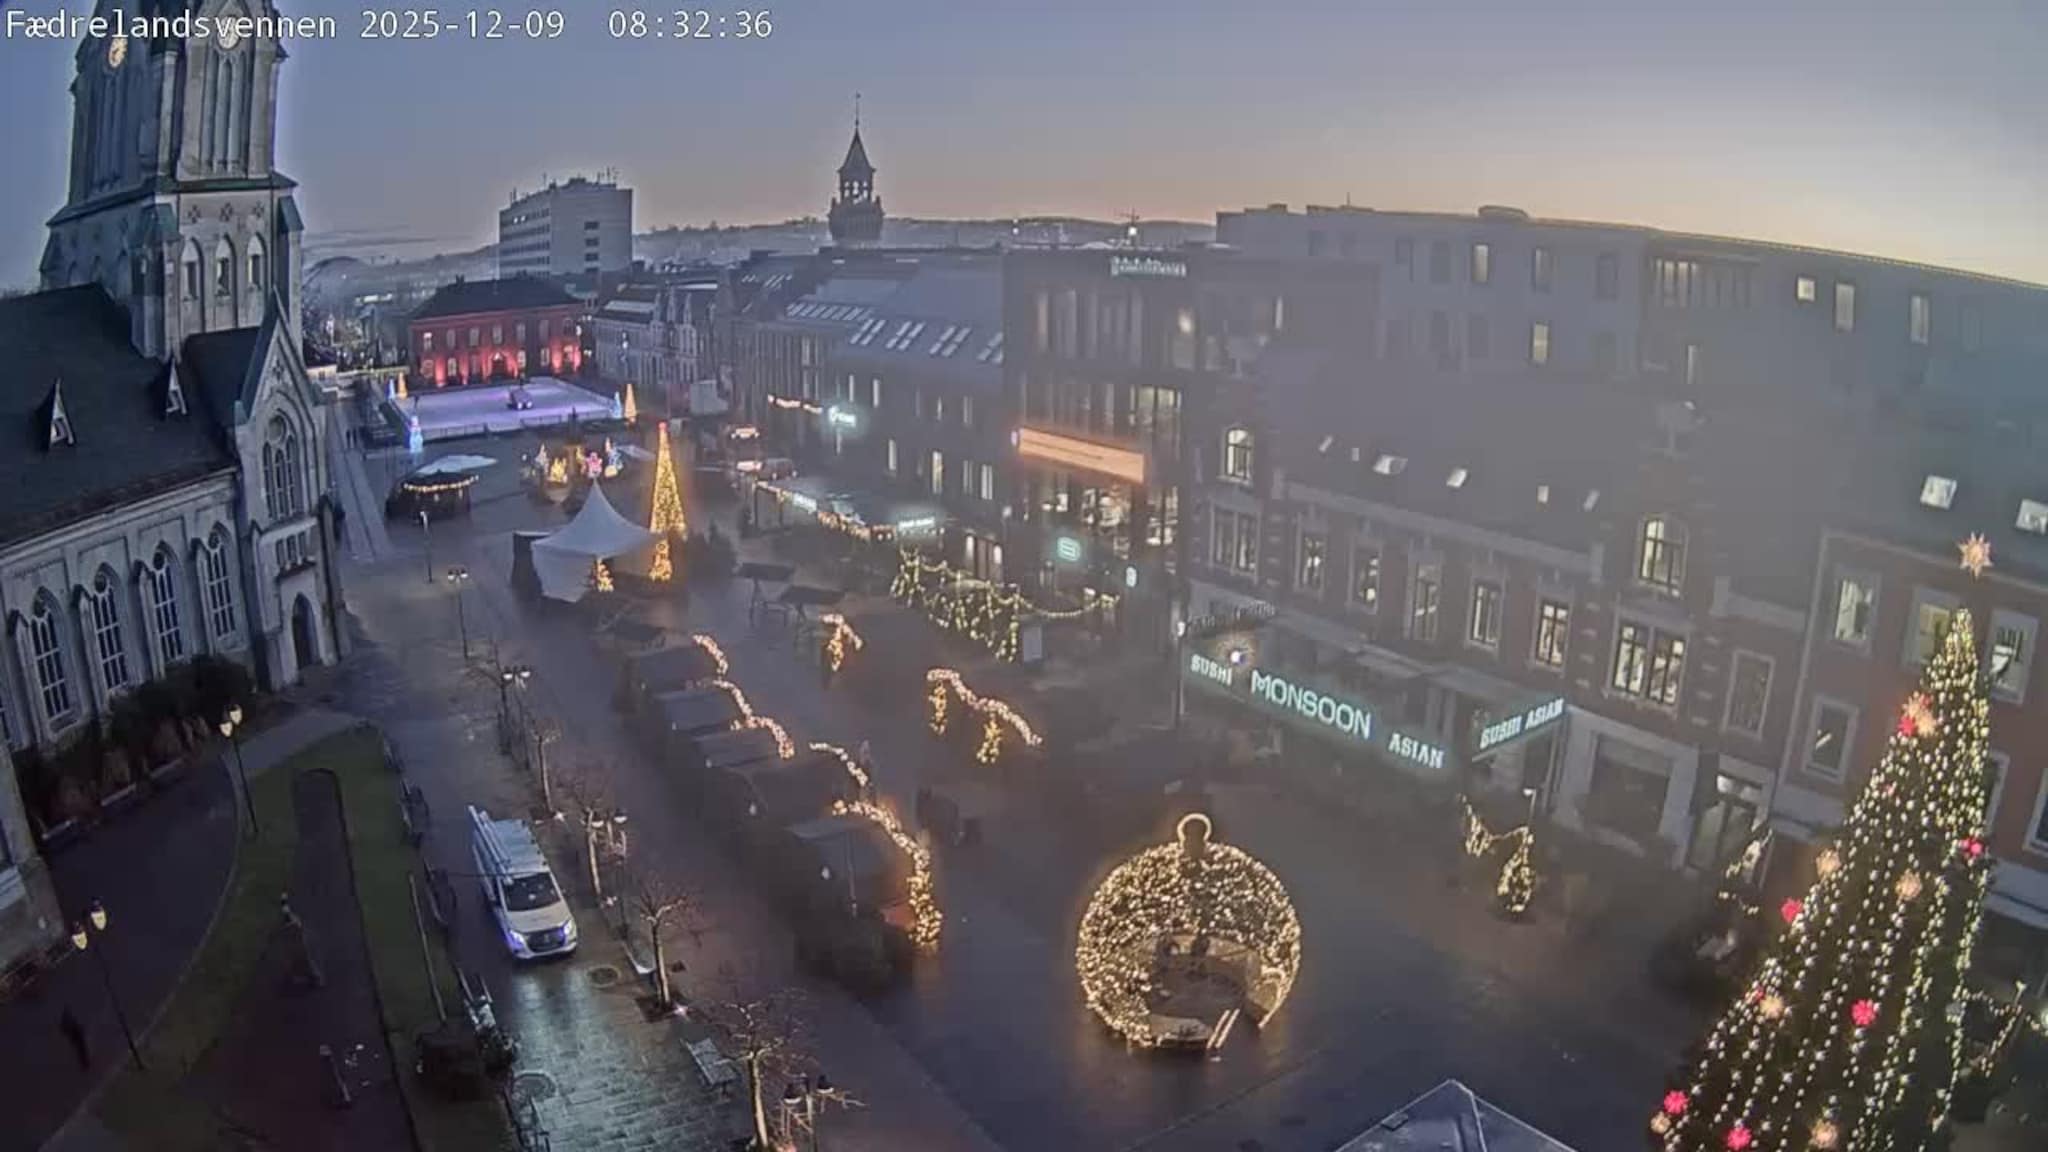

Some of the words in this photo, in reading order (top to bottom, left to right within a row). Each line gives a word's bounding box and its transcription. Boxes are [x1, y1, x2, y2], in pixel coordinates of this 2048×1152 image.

[1191, 654, 1232, 685] SUSHI
[1251, 670, 1371, 739] MONSOON
[1388, 733, 1444, 769] ASIAN
[1480, 715, 1522, 749] SUSHI
[1525, 698, 1564, 730] ASIAN
